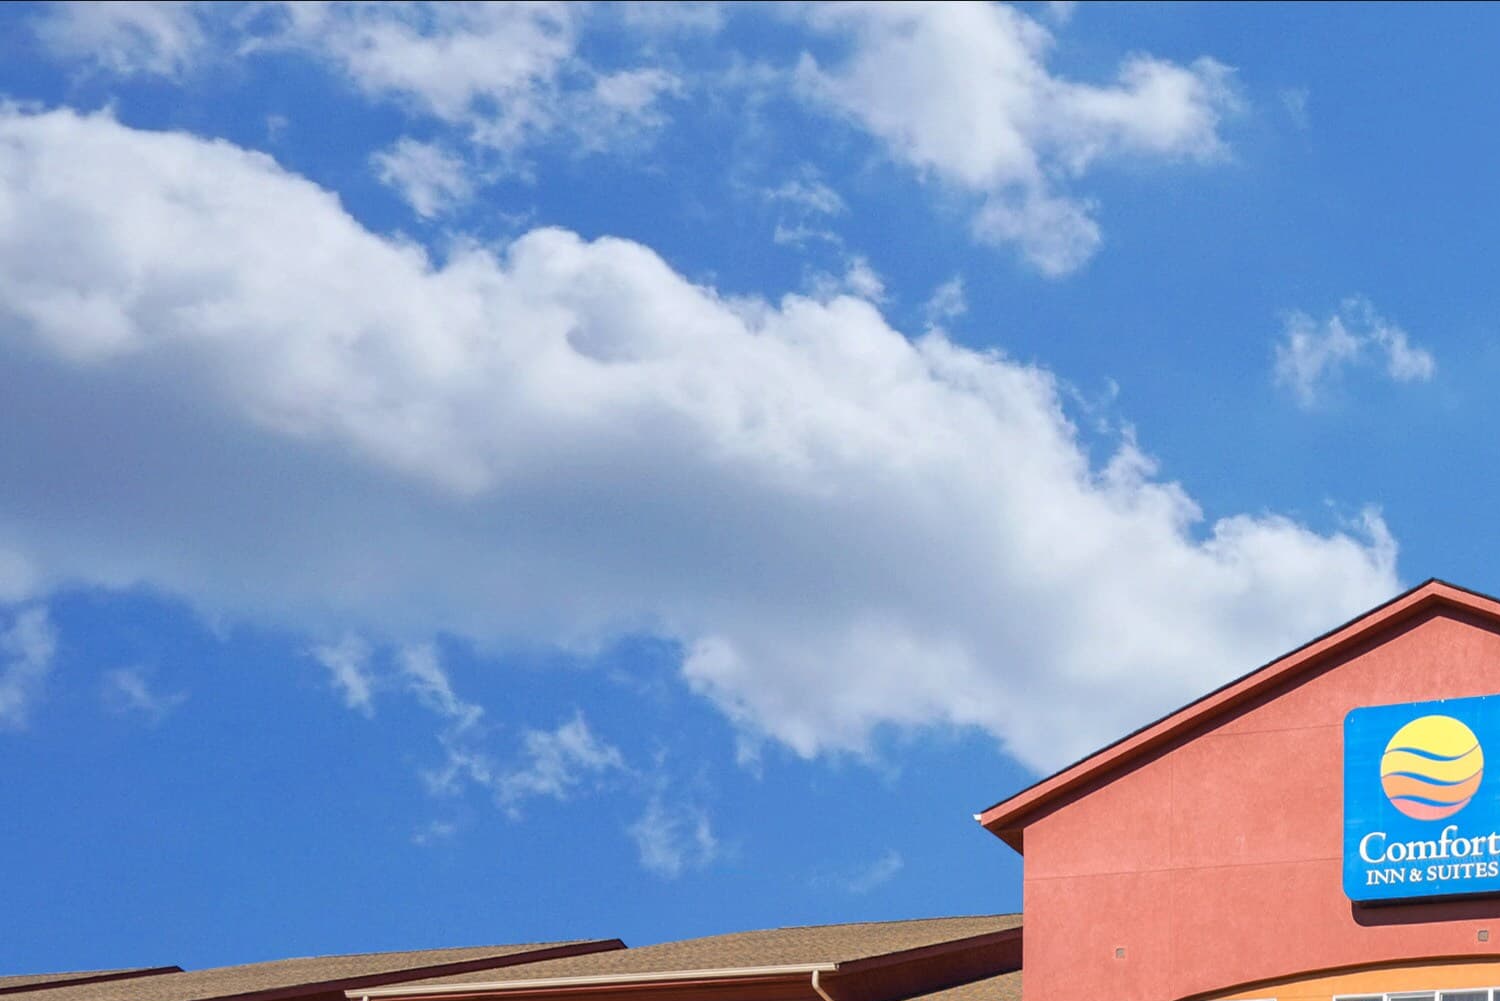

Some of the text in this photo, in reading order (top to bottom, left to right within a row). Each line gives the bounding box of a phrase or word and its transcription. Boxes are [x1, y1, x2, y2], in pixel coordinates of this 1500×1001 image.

[1366, 861, 1499, 885] INN & SUITES
